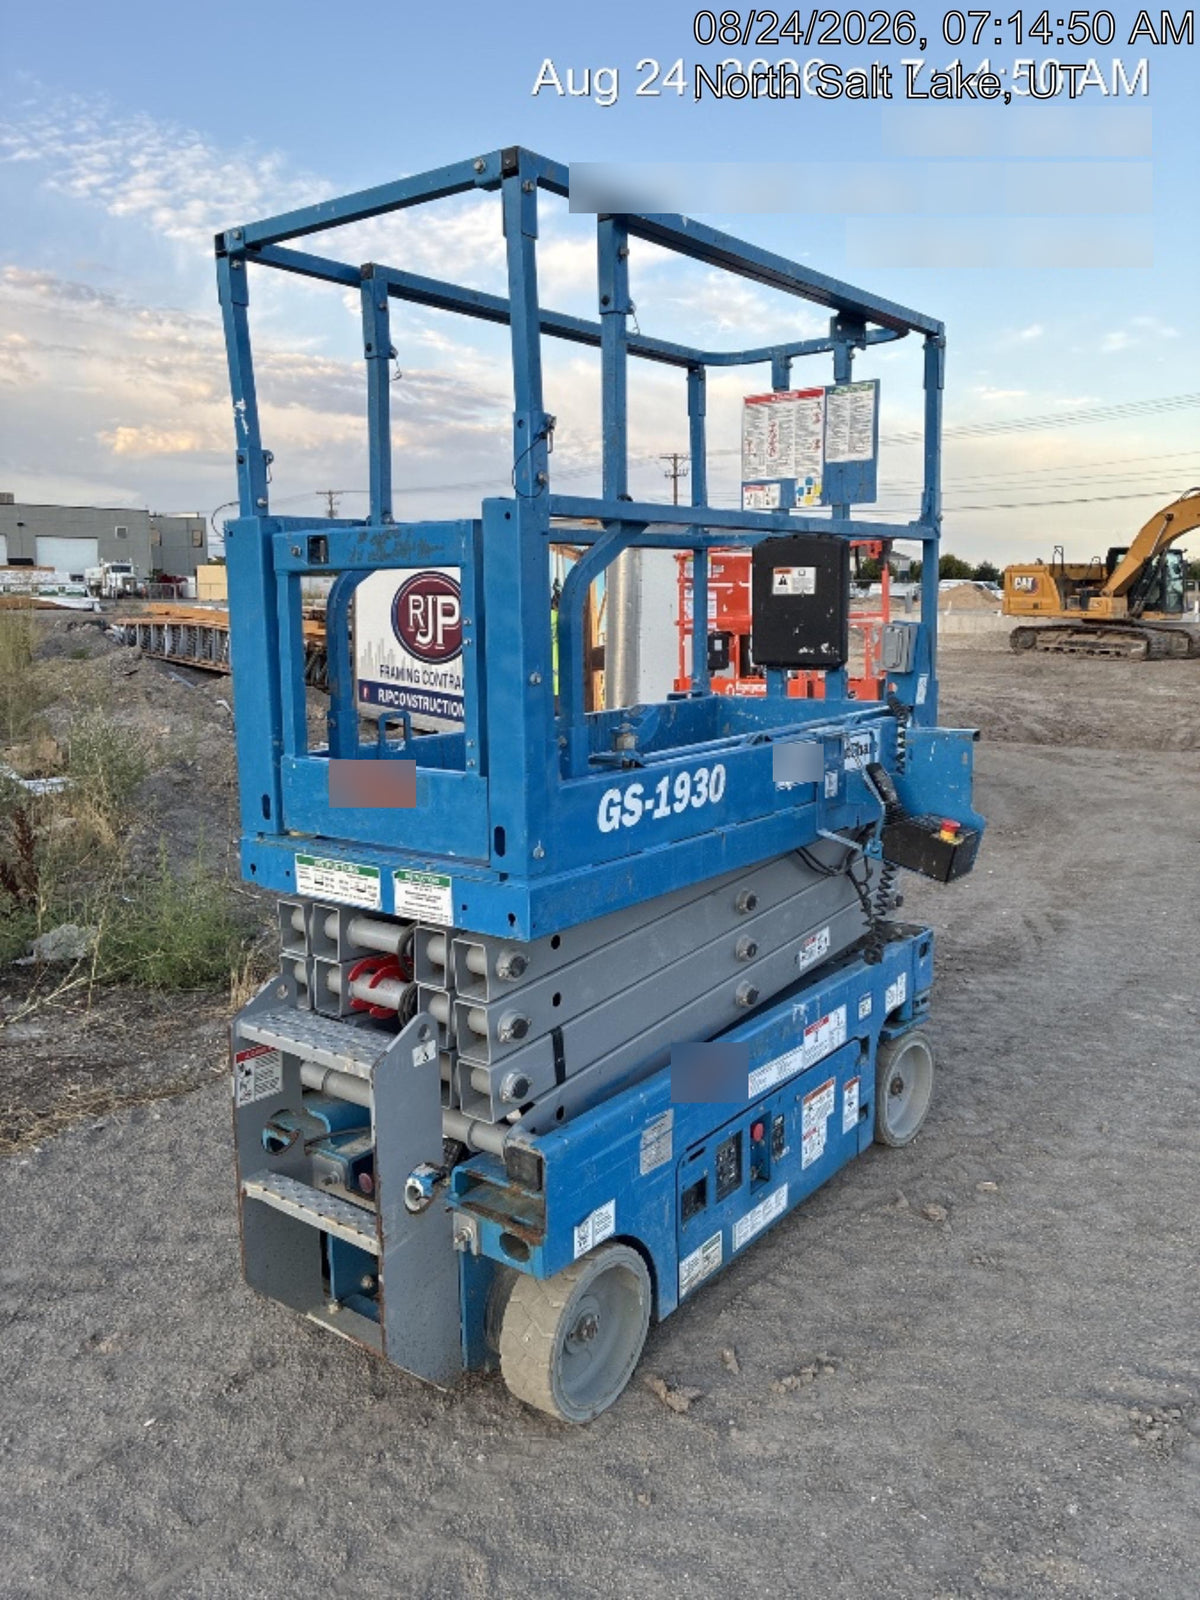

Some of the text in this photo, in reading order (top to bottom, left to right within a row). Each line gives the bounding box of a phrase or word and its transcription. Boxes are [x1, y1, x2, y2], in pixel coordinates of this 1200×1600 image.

[1014, 576, 1034, 591] CAT
[408, 594, 461, 649] RJP
[379, 664, 464, 690] FRAMING CONTRA
[597, 763, 727, 833] GS-1930
